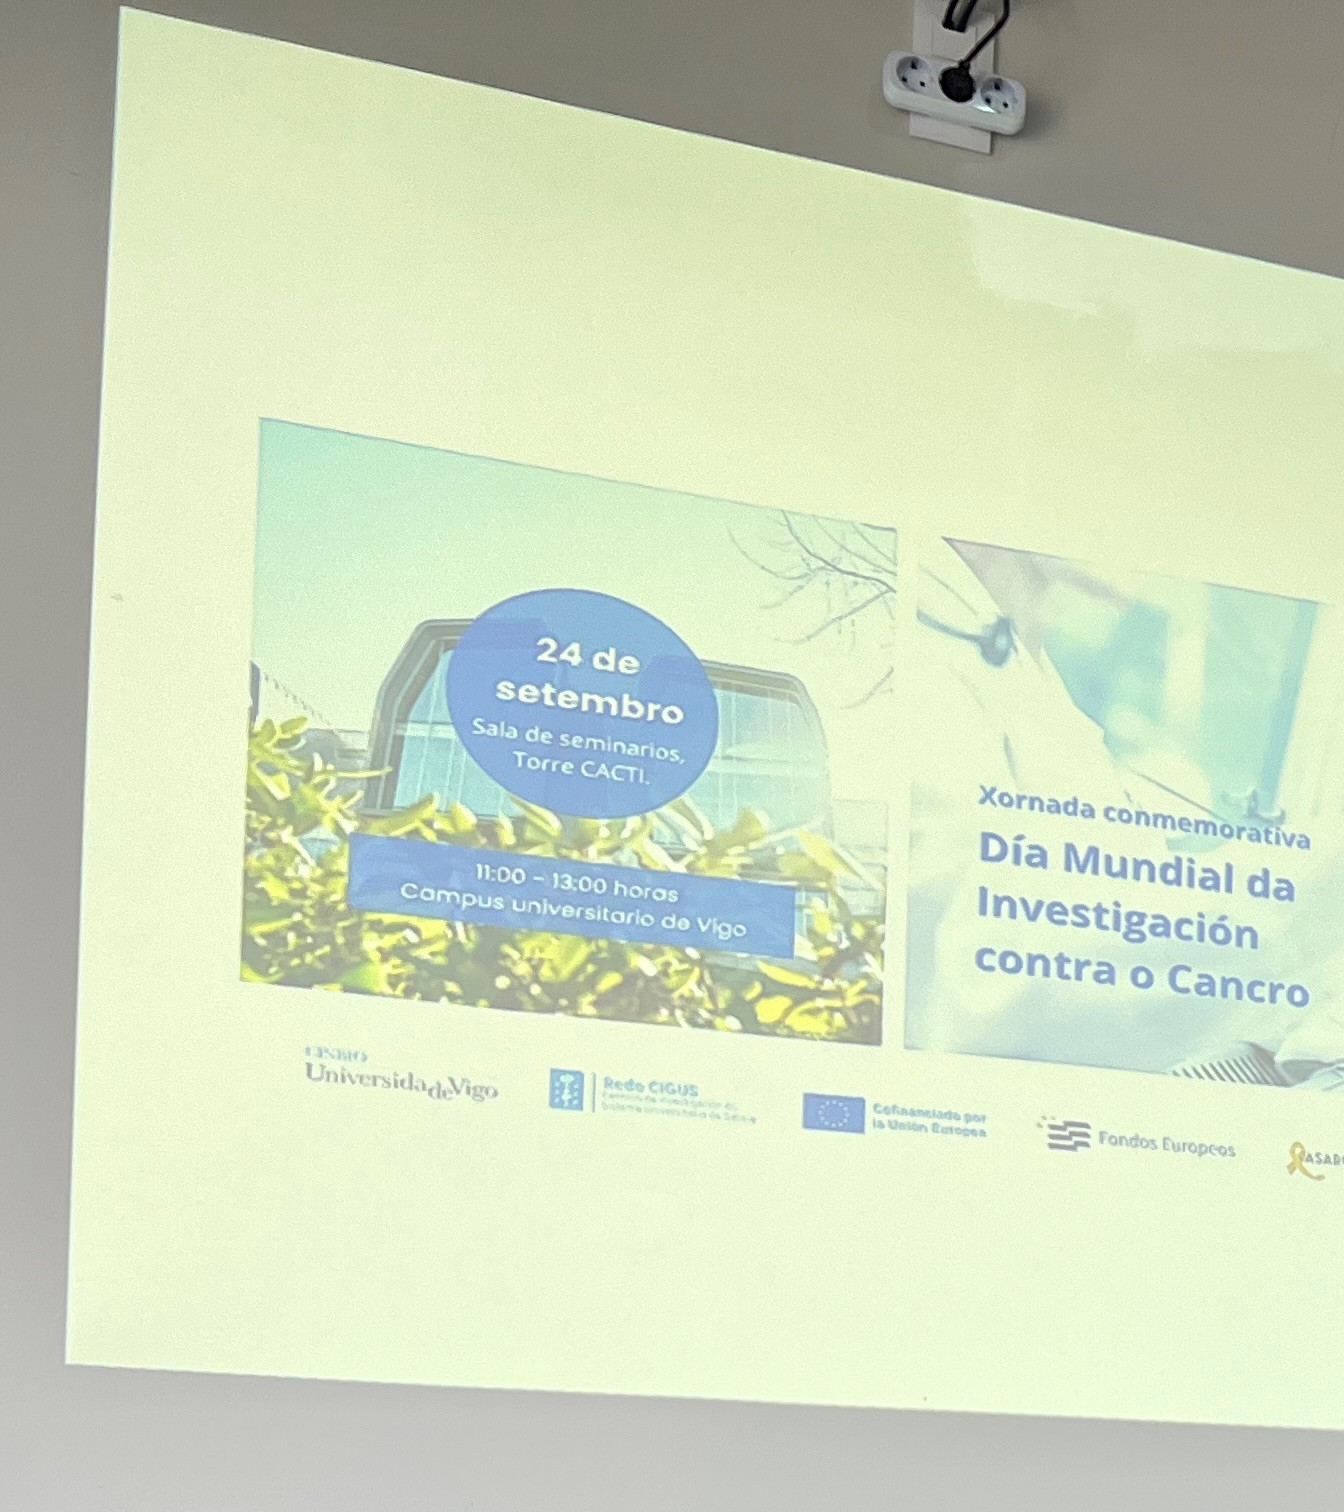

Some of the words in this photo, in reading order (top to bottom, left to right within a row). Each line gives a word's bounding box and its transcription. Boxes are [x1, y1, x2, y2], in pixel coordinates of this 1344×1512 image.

[536, 637, 582, 666] 24
[593, 648, 640, 674] de
[496, 680, 684, 724] setembro
[472, 717, 518, 739] Sala
[525, 726, 552, 744] de
[559, 733, 685, 764] seminarios,
[513, 751, 574, 775] Torre
[581, 761, 650, 784] CACTI.
[978, 784, 1096, 819] Xornada
[1104, 805, 1312, 849] conmemorativa
[475, 864, 525, 884] 11:00
[553, 872, 607, 894] 13:00
[613, 880, 678, 902] horas
[979, 831, 1048, 869] Día
[1064, 842, 1233, 894] Mundial
[1247, 868, 1296, 902] da
[400, 883, 505, 911] Campus
[512, 898, 654, 928] universitario
[661, 912, 690, 930] de
[698, 917, 747, 940] Vigo
[978, 886, 1259, 949] Investigación
[974, 946, 1116, 985] contra
[1130, 966, 1154, 989] o
[1168, 964, 1310, 1008] Cancro
[1099, 1129, 1157, 1151] Fondos
